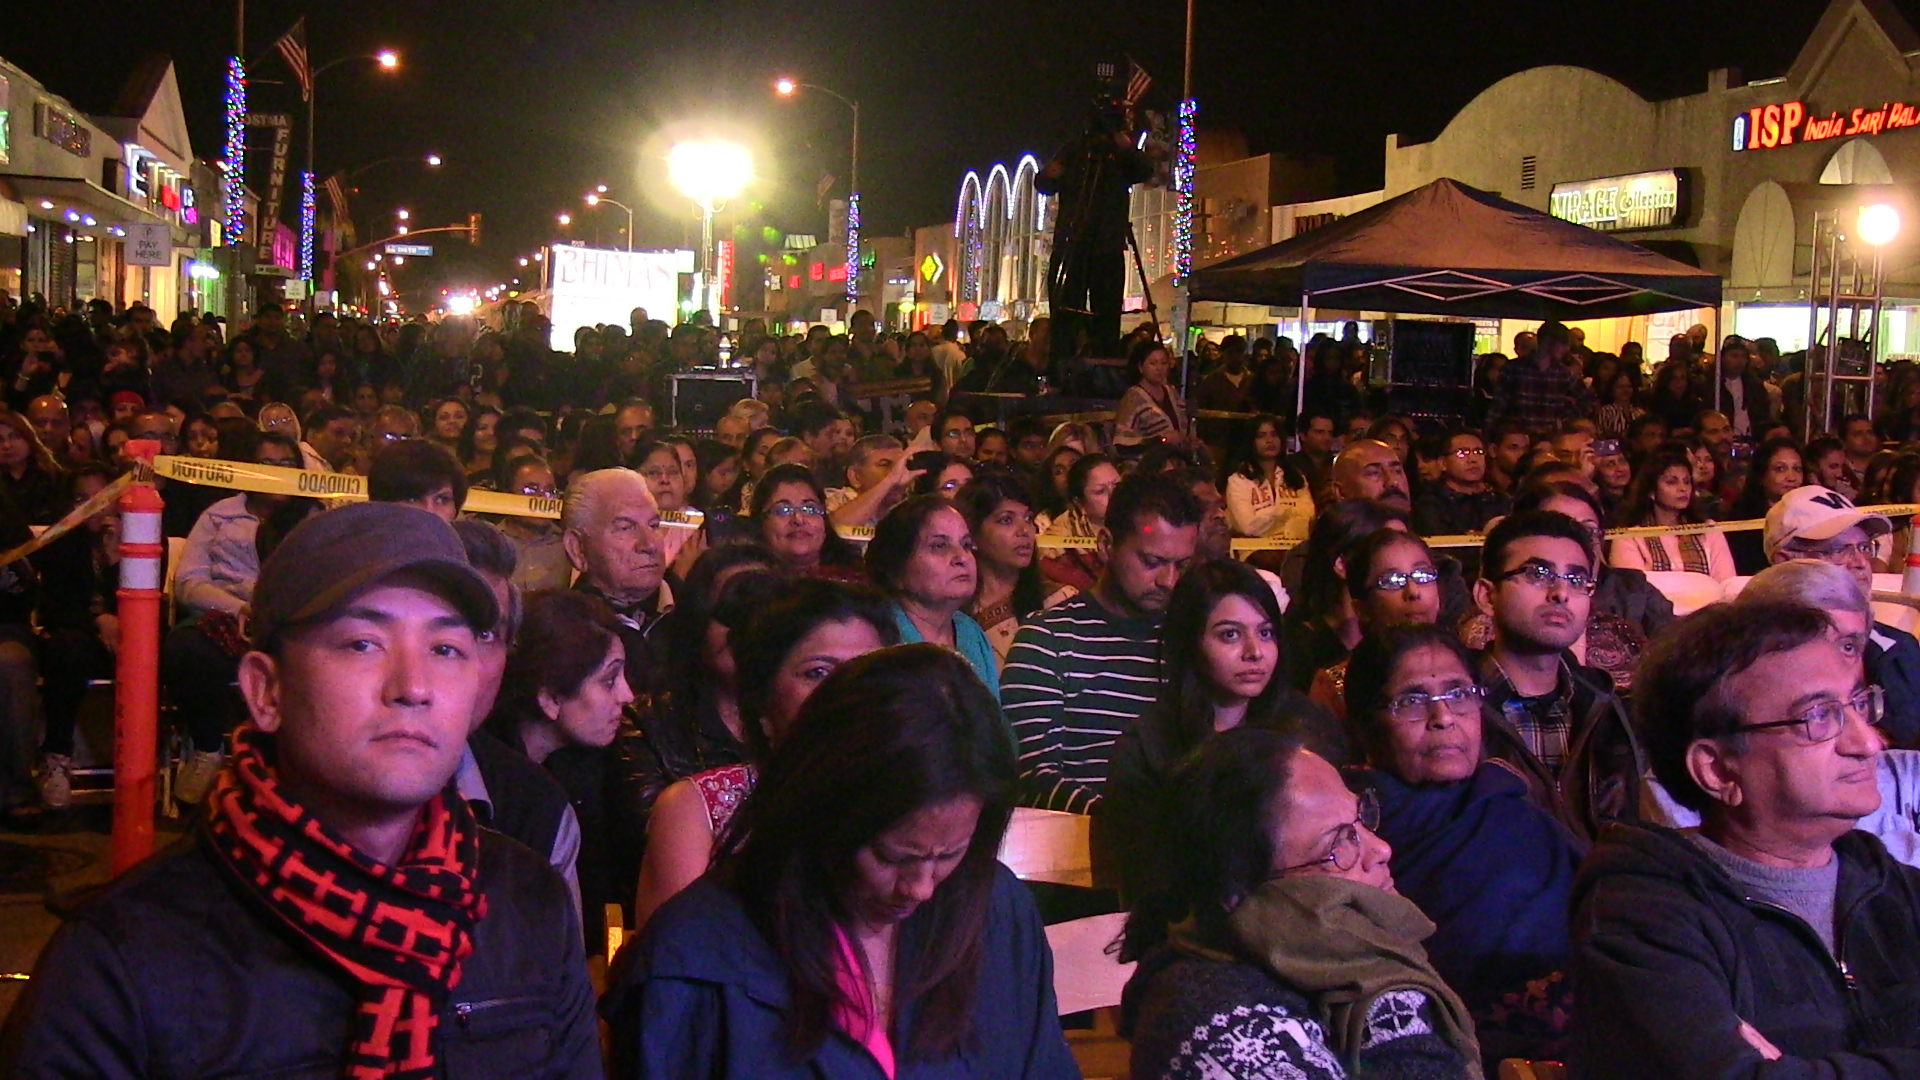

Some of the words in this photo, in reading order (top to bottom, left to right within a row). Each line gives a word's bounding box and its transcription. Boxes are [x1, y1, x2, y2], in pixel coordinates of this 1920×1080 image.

[1748, 101, 1804, 149] ISP
[259, 128, 290, 260] FURNITURE
[135, 249, 162, 260] HERE
[138, 240, 159, 249] PAY
